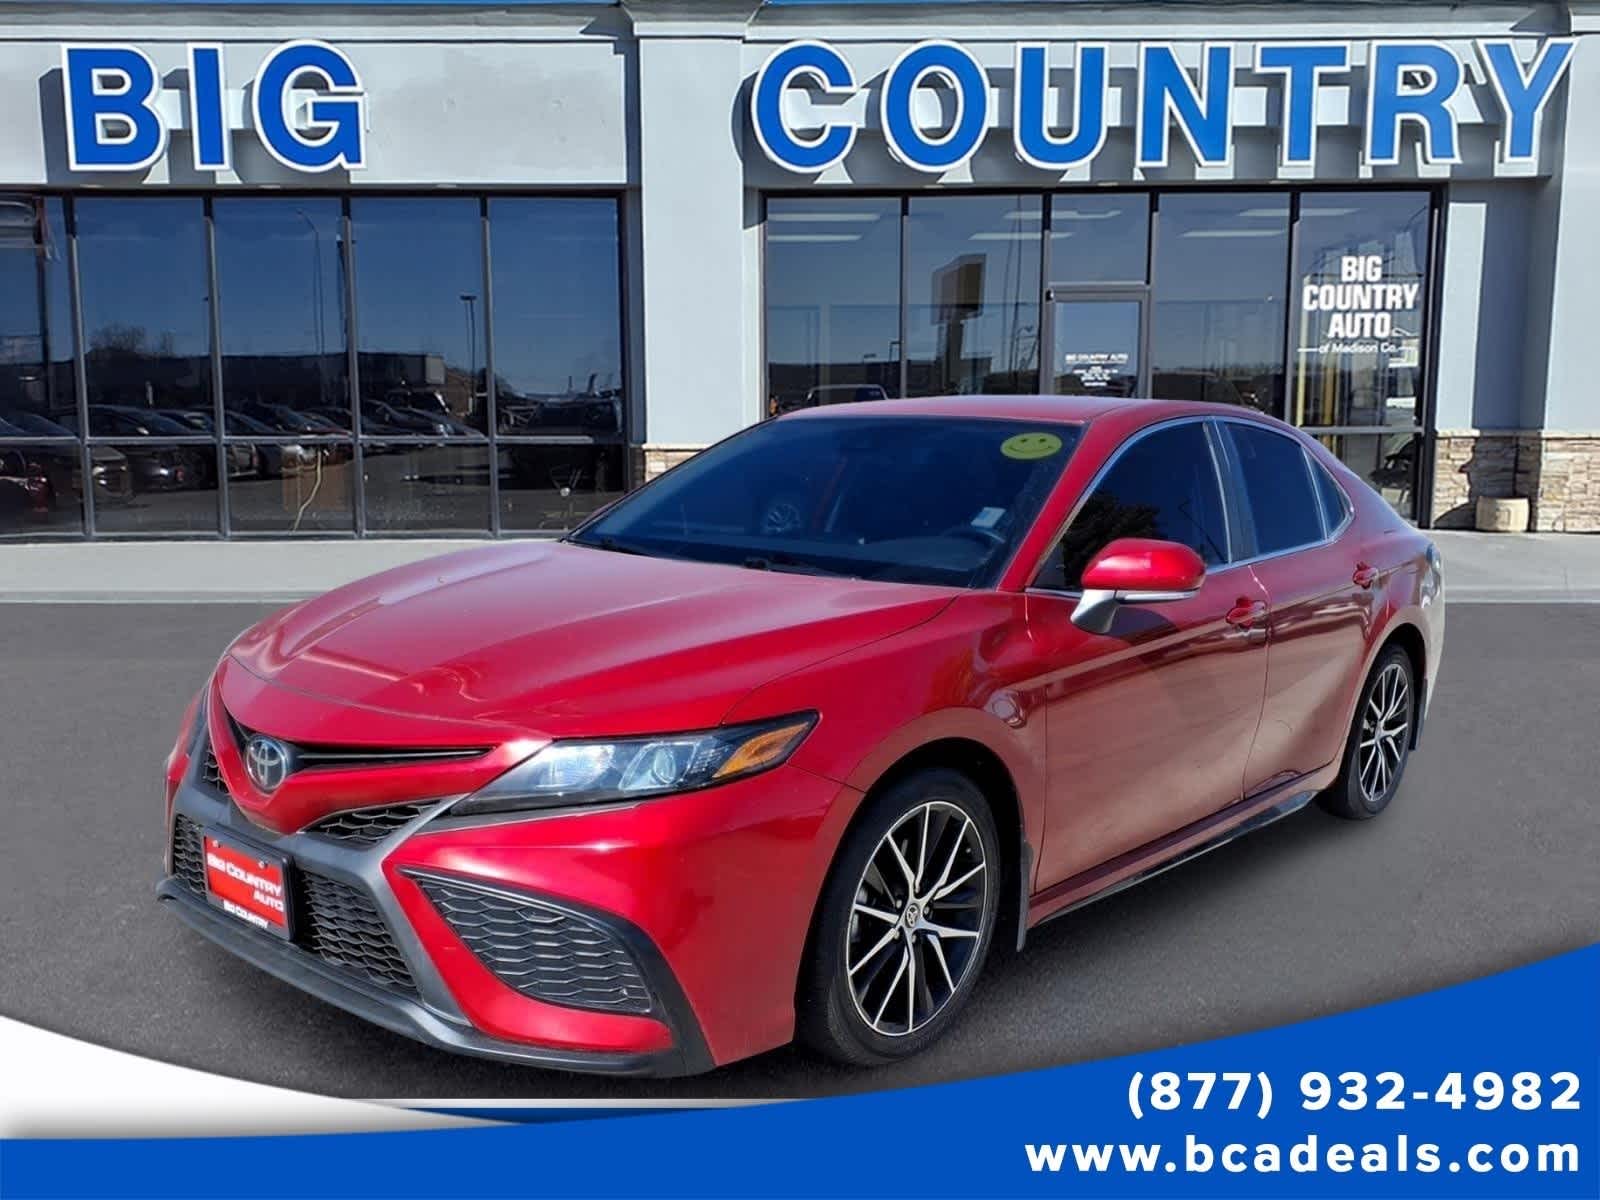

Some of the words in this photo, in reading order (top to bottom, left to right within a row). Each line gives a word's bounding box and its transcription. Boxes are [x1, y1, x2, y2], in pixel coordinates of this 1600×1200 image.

[61, 39, 367, 172] BIG
[750, 38, 1575, 174] COUNTRY
[1341, 255, 1383, 282] BIG
[1303, 283, 1420, 311] COUNTRY
[1328, 312, 1392, 339] AUTO
[1331, 343, 1378, 353] Madison
[226, 861, 282, 897] COUNTRY
[254, 890, 284, 913] AUTO
[235, 905, 269, 929] COUNTRY
